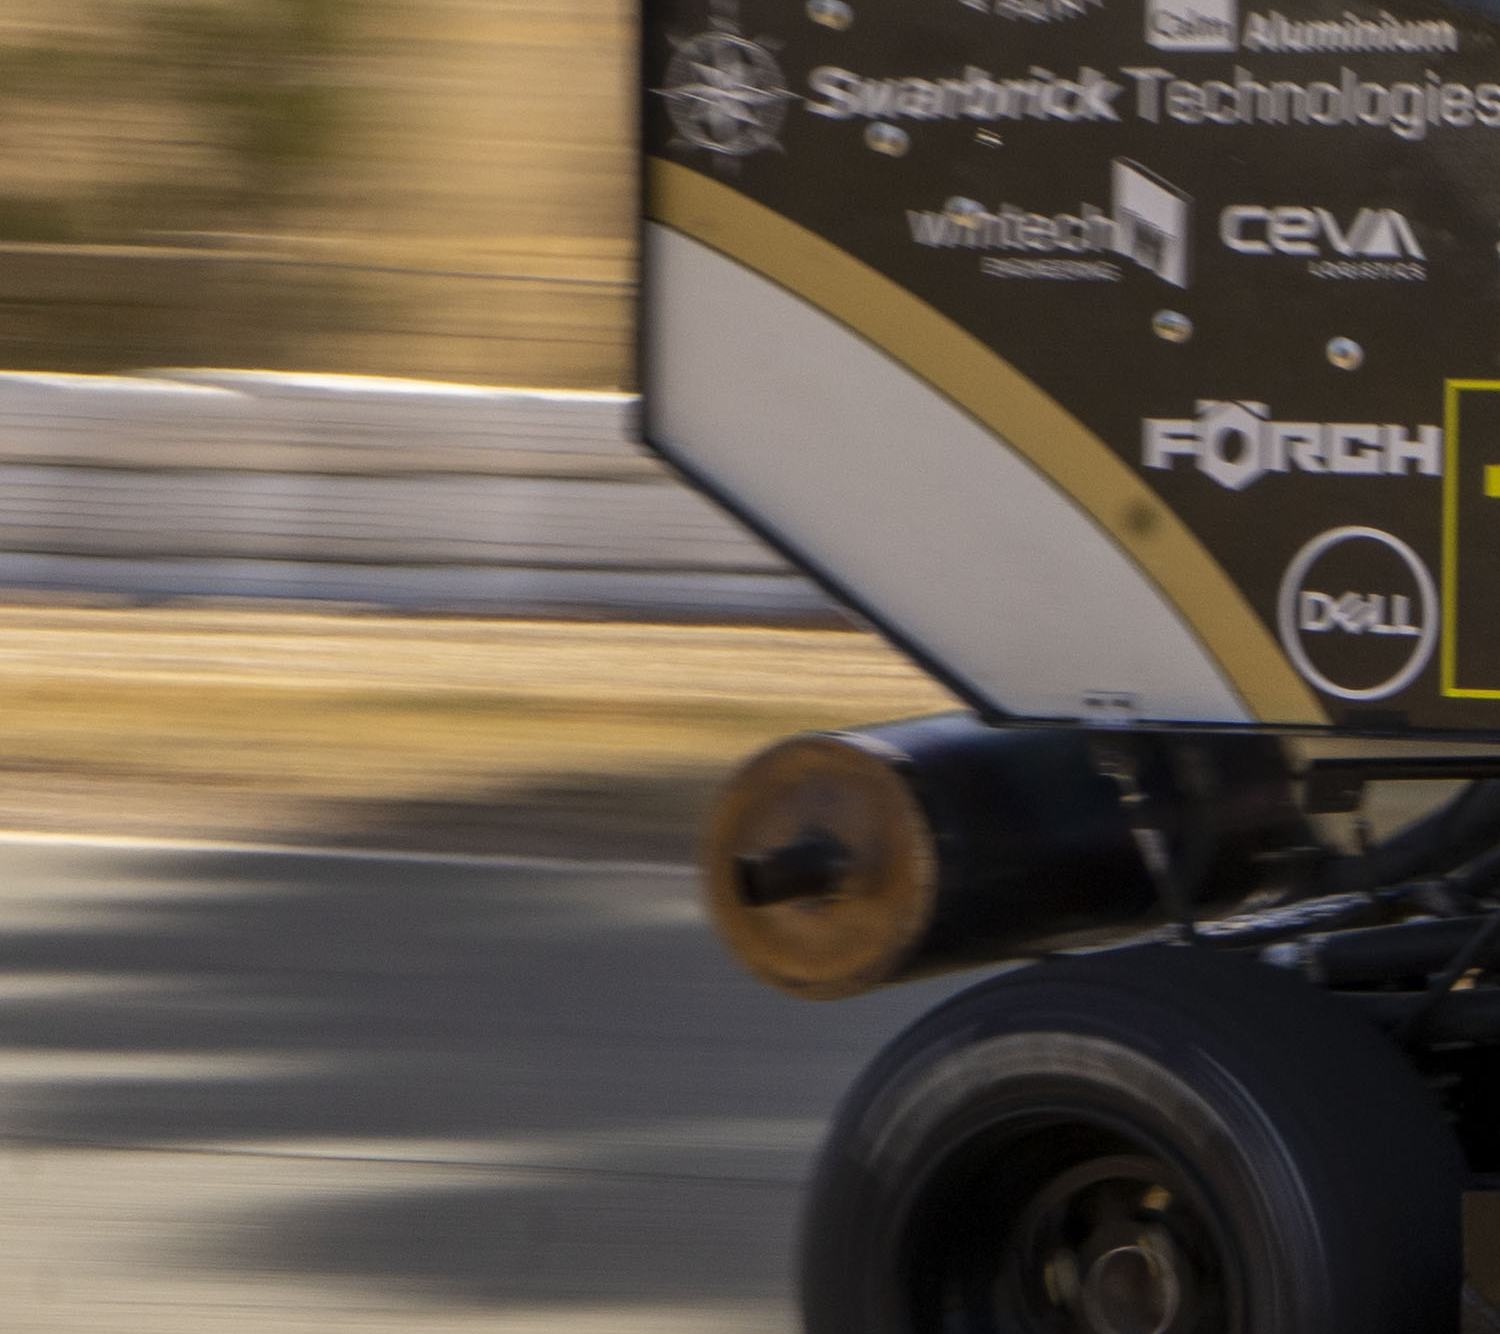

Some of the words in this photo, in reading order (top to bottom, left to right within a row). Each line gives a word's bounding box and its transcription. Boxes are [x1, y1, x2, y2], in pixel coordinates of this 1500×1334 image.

[804, 65, 1124, 123] Swarbrick
[1219, 204, 1426, 261] CEVA
[1299, 591, 1422, 636] DELL
